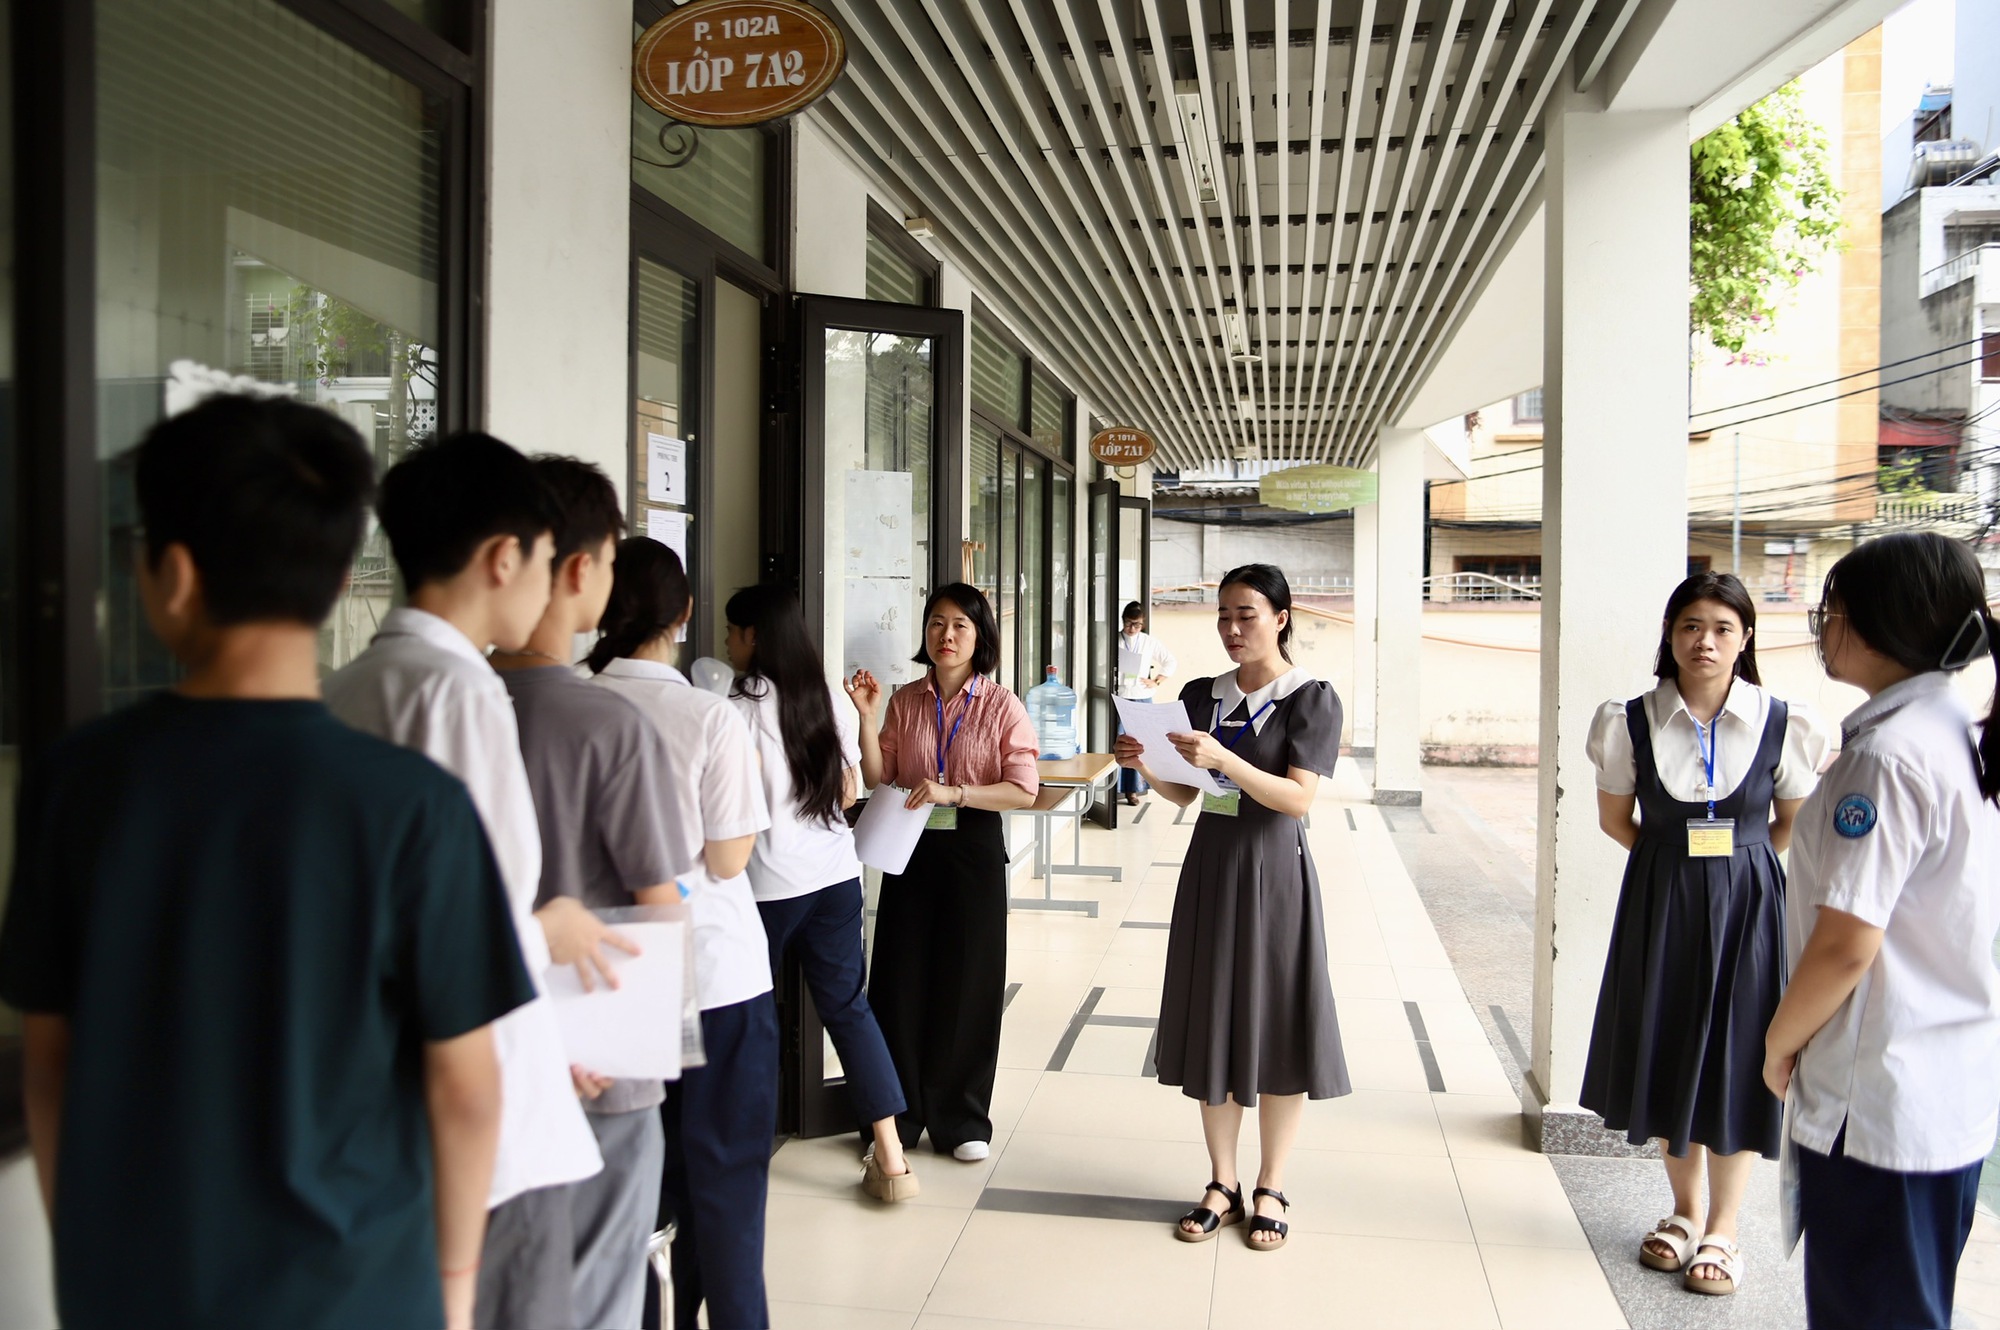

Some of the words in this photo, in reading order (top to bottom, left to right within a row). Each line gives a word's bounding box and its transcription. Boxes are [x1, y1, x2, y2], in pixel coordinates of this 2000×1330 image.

[694, 21, 713, 42] P.
[721, 15, 781, 40] 102A
[666, 46, 735, 97] LỚP
[744, 50, 807, 89] 7A2
[1100, 442, 1122, 456] LỚP
[1124, 445, 1143, 456] 7A1
[664, 471, 671, 492] 2
[1275, 480, 1290, 489] With
[1310, 480, 1320, 489] but
[1321, 480, 1343, 488] without
[1308, 492, 1316, 500] for
